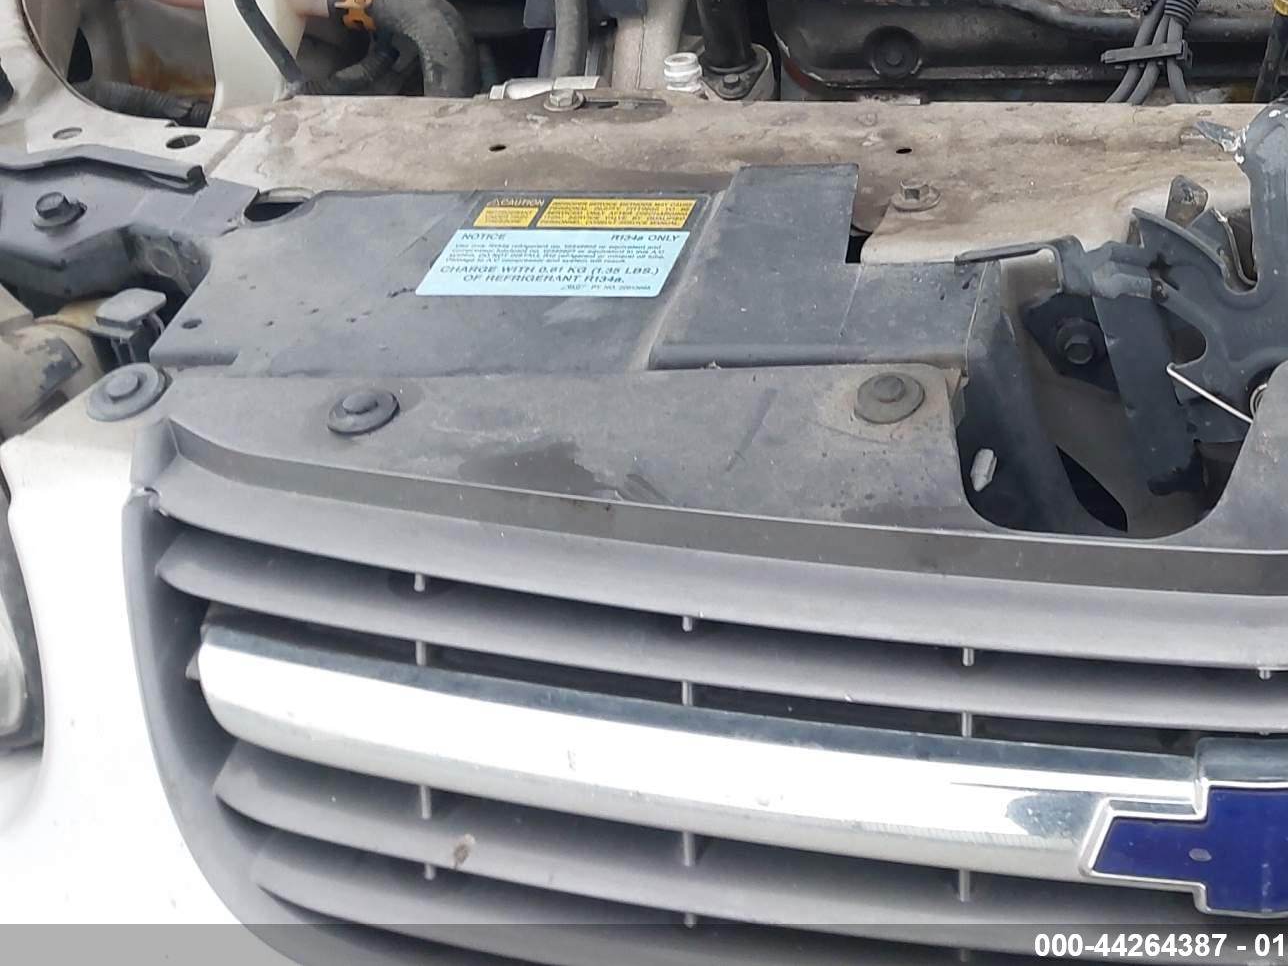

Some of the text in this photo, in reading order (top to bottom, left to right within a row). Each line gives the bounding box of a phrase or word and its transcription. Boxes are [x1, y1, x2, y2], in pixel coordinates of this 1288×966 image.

[461, 233, 507, 241] NOTICE
[610, 234, 680, 242] R134a ONLY
[440, 266, 498, 274] CHARGE
[501, 266, 537, 274] WITH
[568, 266, 588, 274] KG
[624, 266, 660, 276] LBS.)
[485, 275, 580, 283] REFRIGERANT
